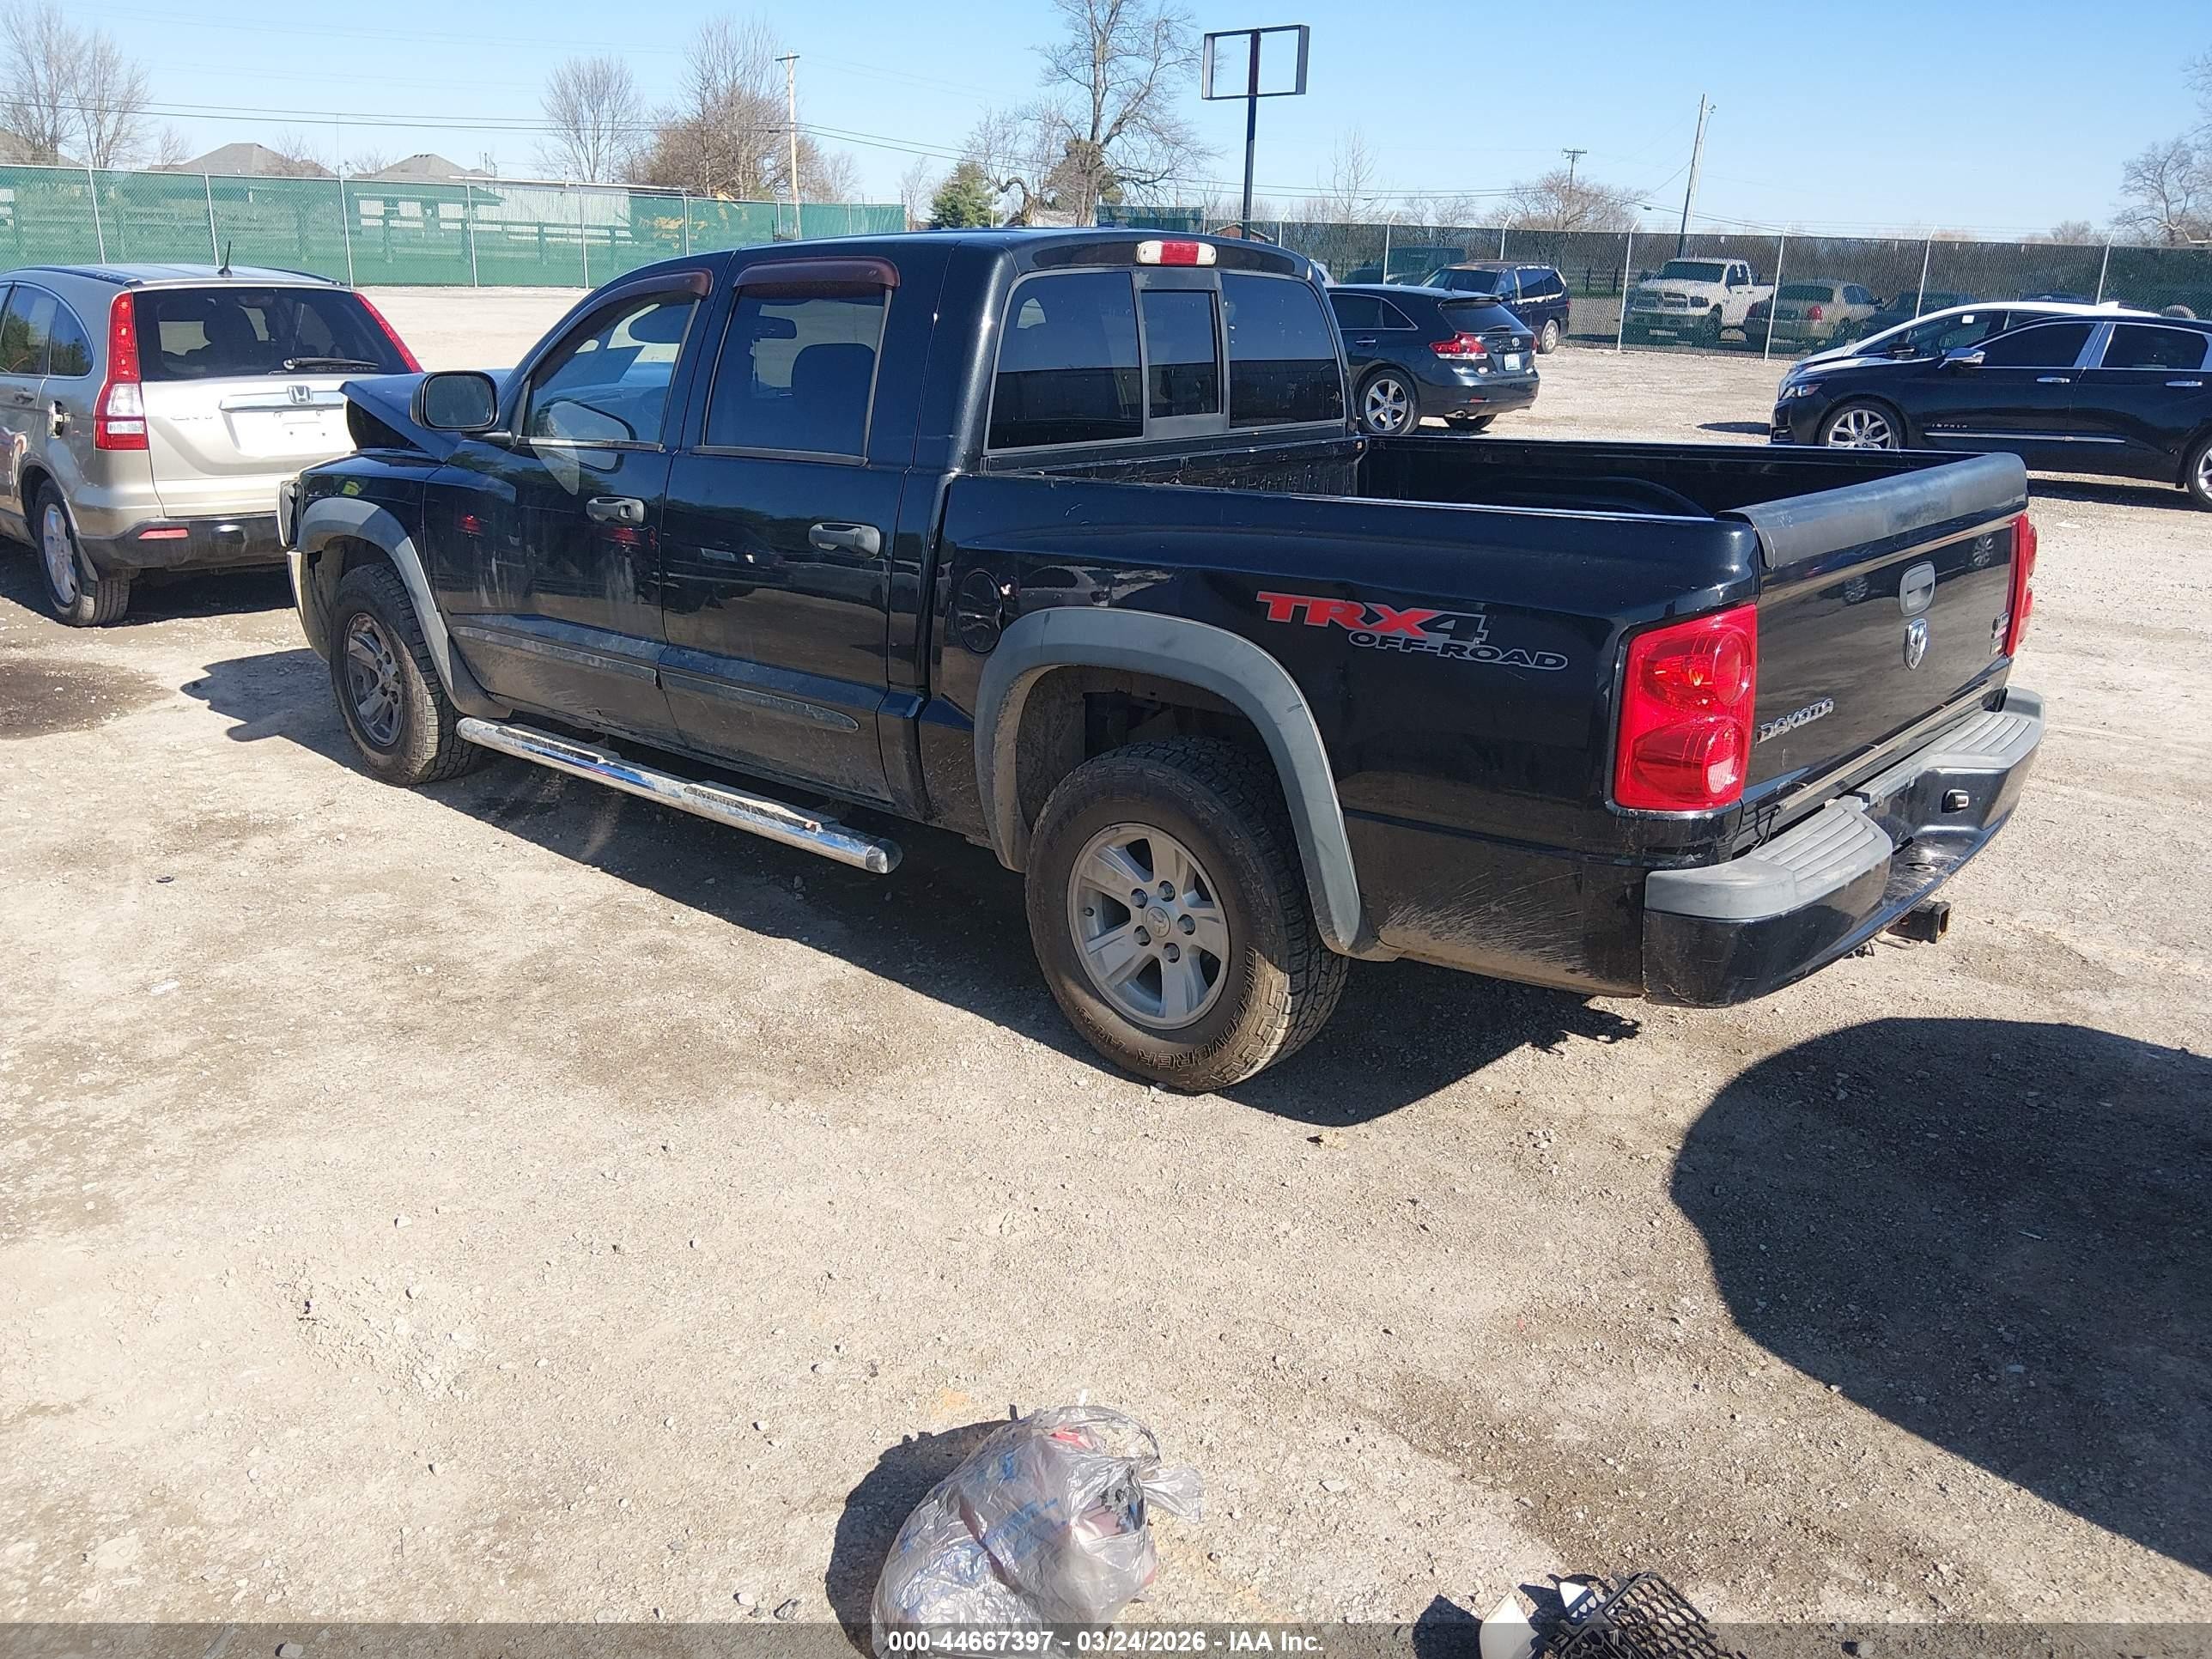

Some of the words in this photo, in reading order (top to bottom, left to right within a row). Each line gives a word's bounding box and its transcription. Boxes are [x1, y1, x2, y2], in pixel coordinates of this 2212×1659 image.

[1255, 590, 1489, 642] TRX4
[1347, 630, 1569, 672] OFF-ROAD
[1757, 697, 1835, 744] DAKOTA
